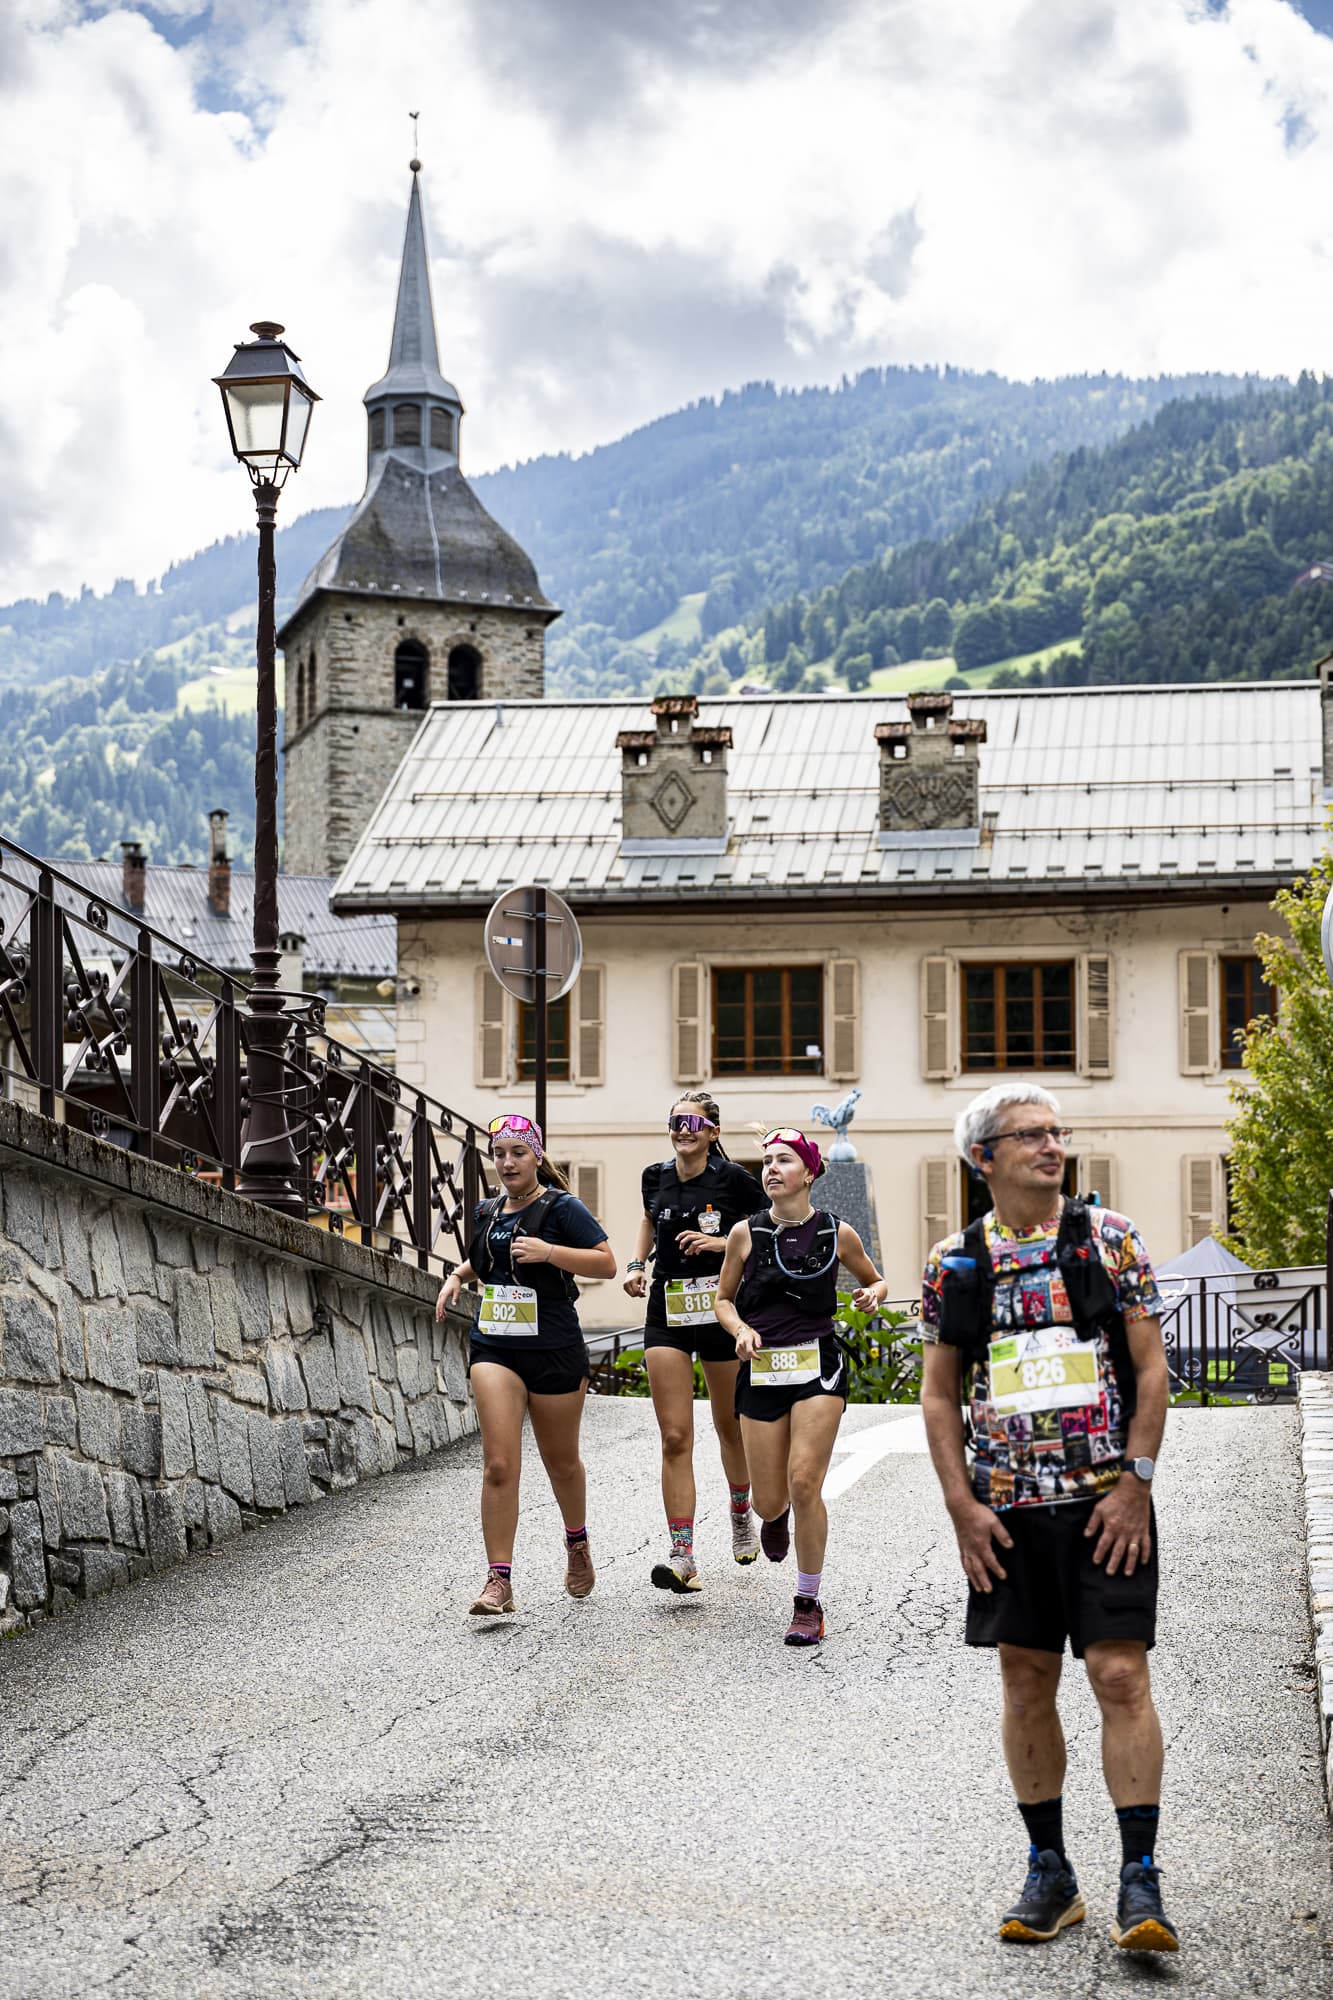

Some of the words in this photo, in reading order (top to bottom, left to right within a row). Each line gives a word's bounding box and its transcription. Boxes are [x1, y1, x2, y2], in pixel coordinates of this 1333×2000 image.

[684, 1293, 712, 1312] 818
[492, 1303, 517, 1321] 902
[771, 1352, 798, 1370] 888
[1021, 1356, 1067, 1389] 826
